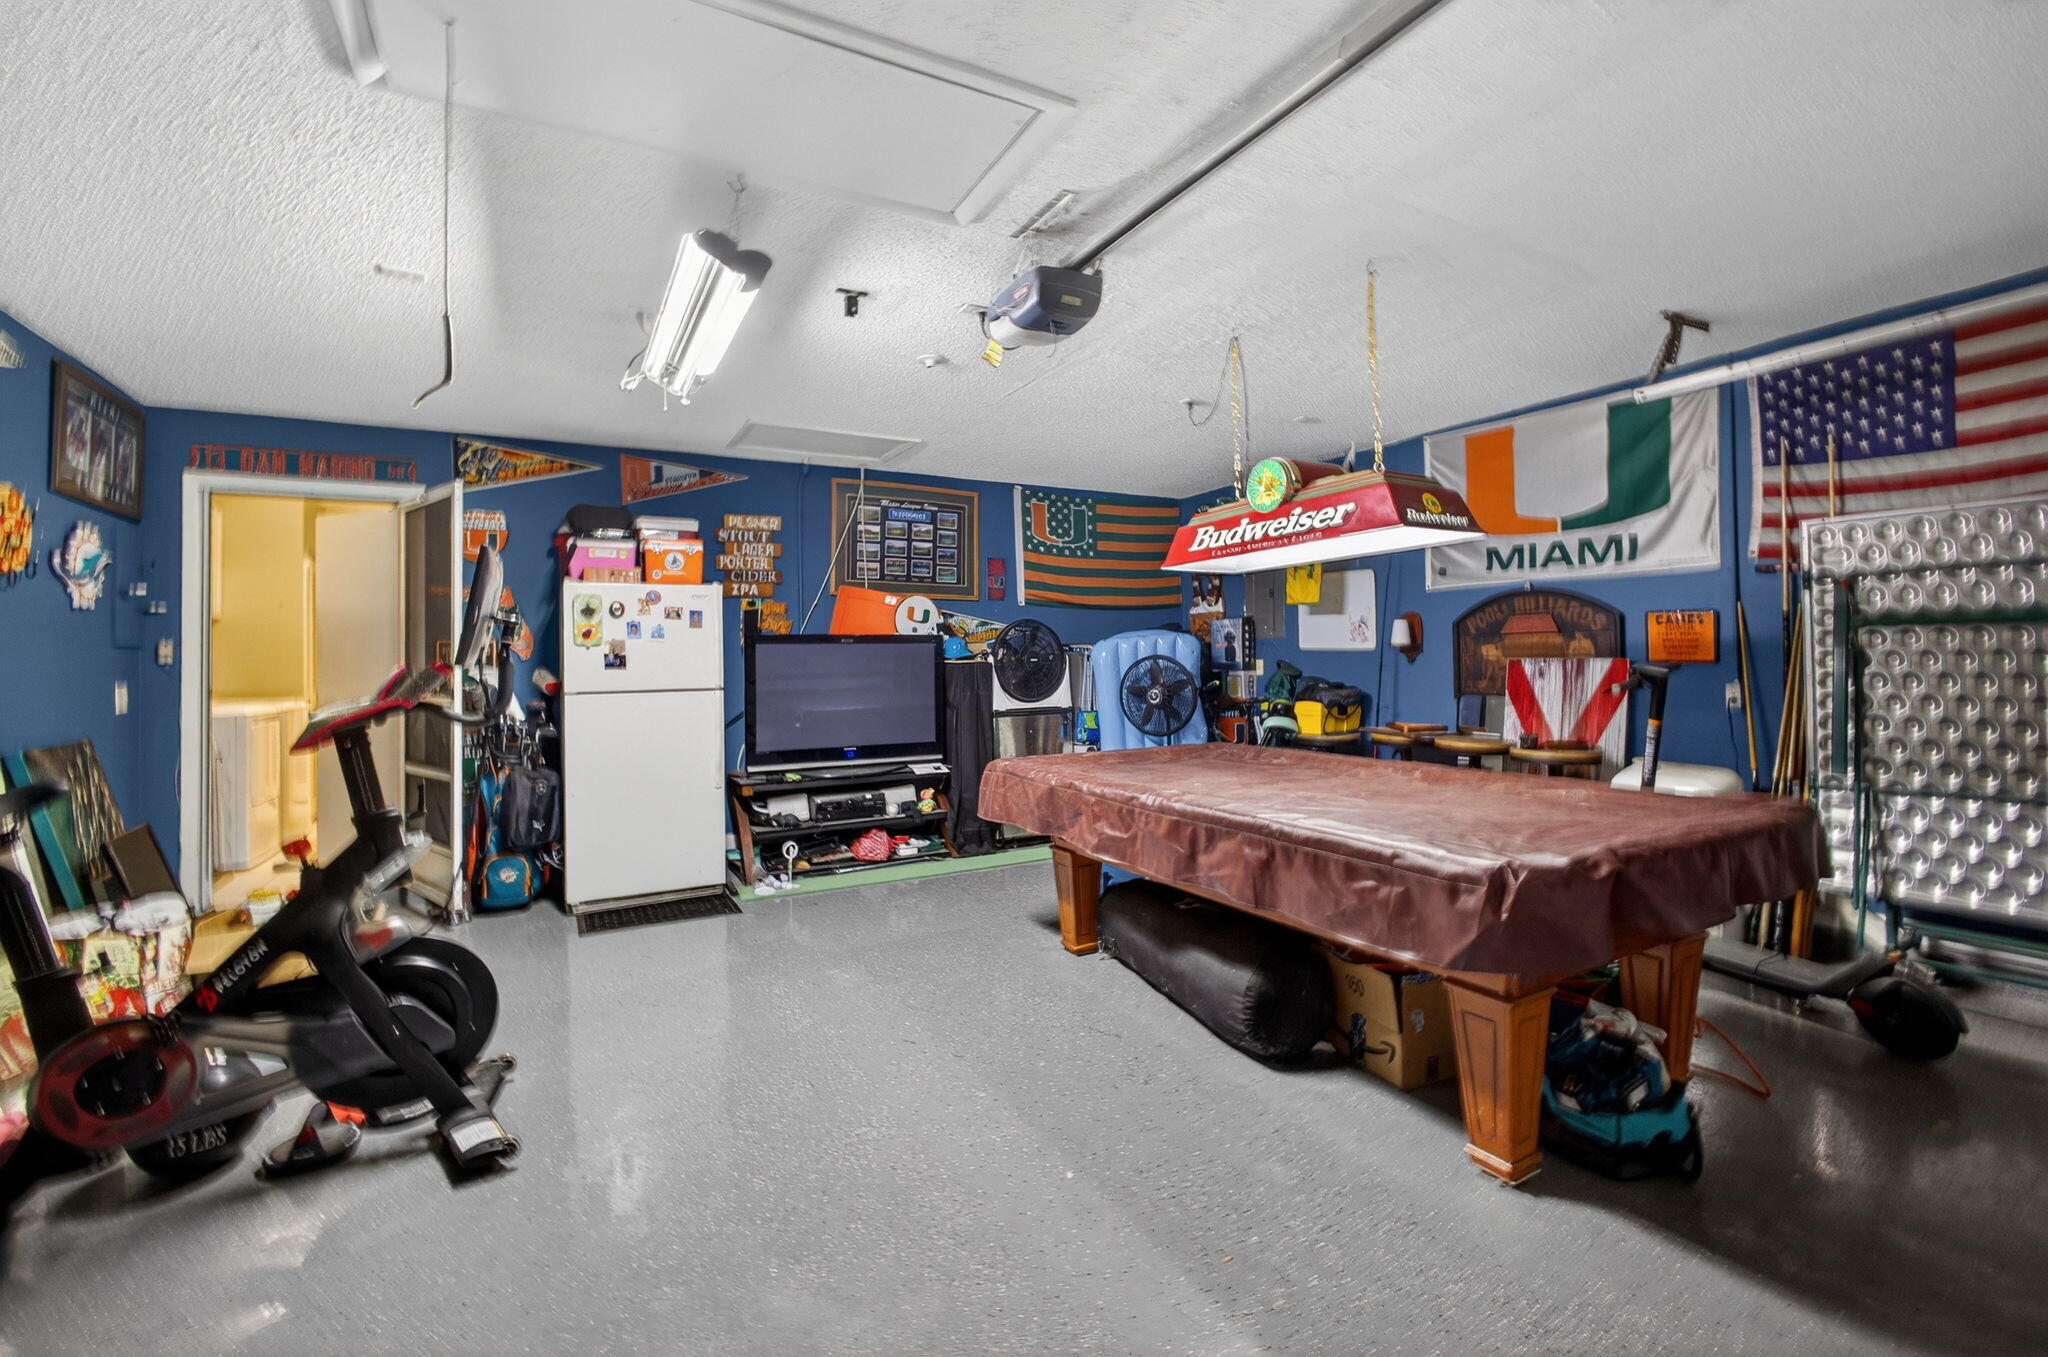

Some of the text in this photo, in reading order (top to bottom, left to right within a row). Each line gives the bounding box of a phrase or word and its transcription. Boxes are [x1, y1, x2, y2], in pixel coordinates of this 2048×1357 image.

[1188, 502, 1356, 552] Budweiser
[733, 542, 775, 556] LAGER
[1486, 533, 1639, 571] MIAMI
[719, 556, 768, 570] PORTER
[731, 583, 758, 596] IPA
